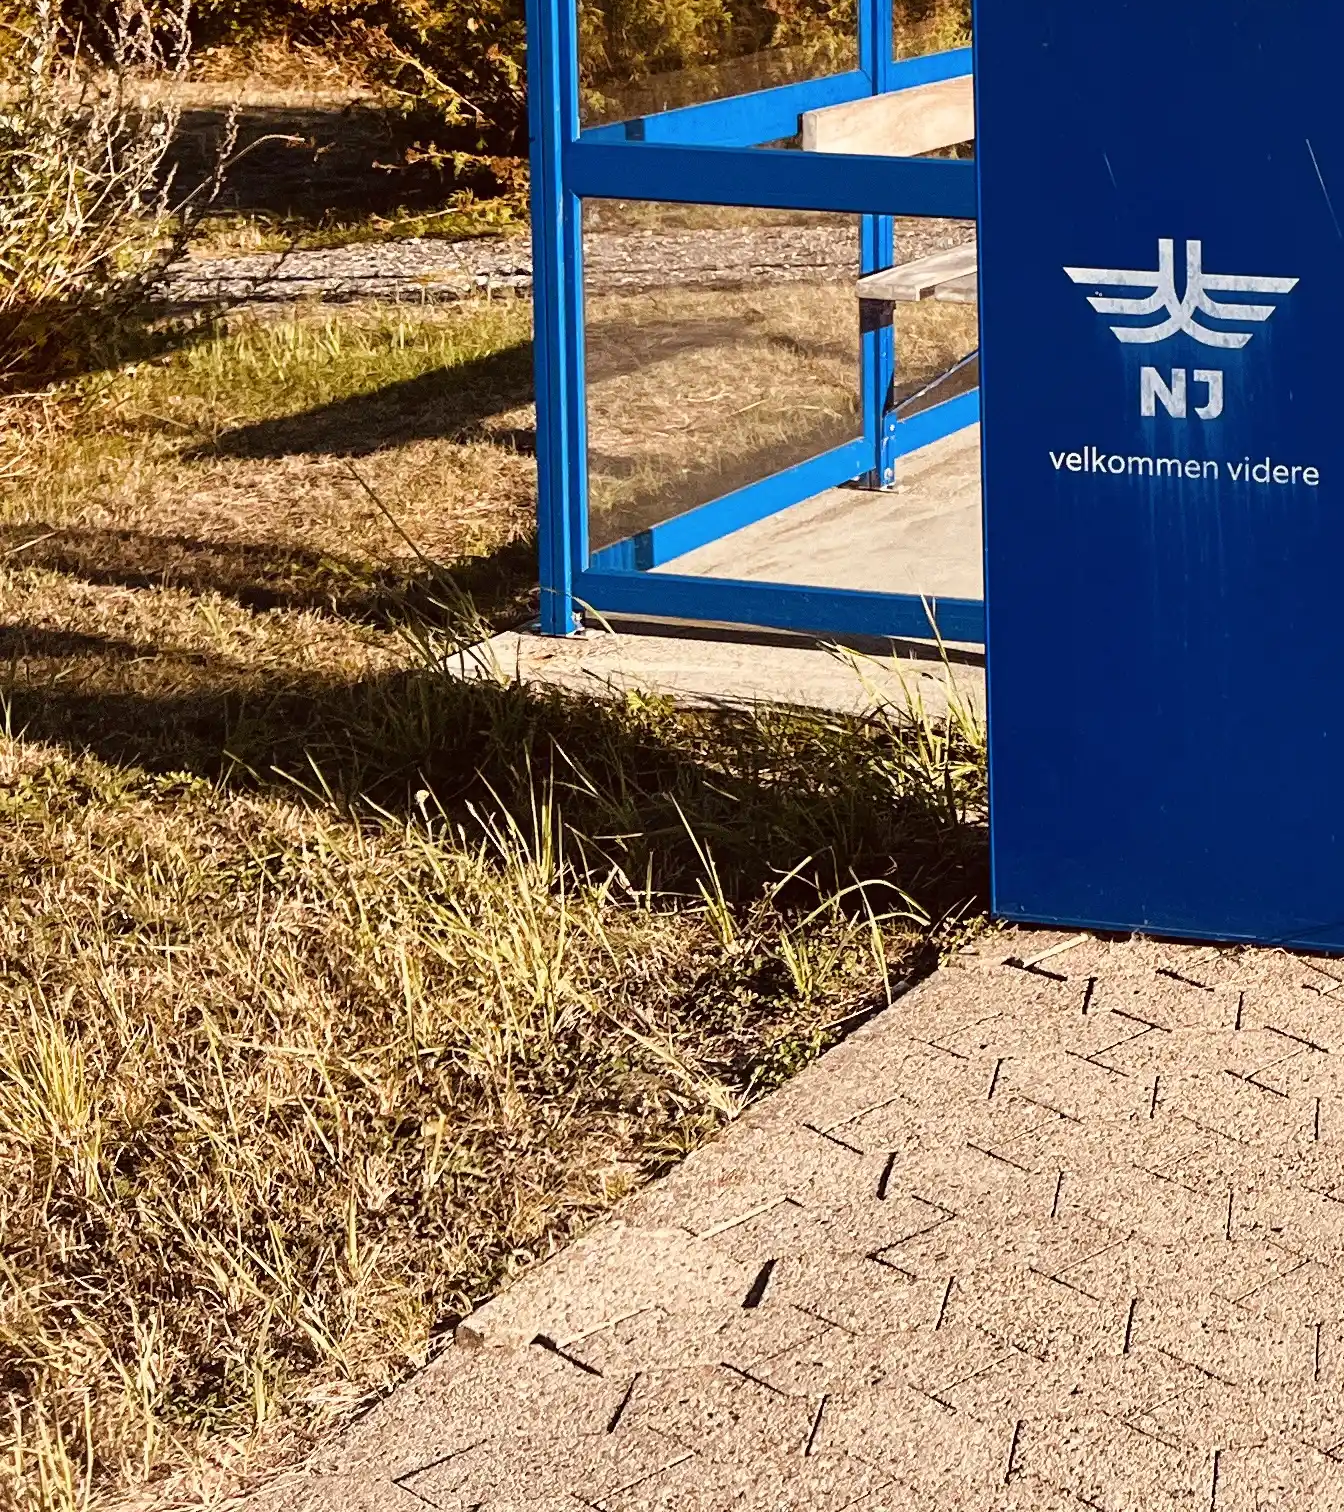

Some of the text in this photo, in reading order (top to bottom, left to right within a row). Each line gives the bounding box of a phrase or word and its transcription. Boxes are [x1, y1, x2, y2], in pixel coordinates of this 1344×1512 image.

[1139, 366, 1224, 420] NJ
[1048, 445, 1321, 487] velkommen videre
